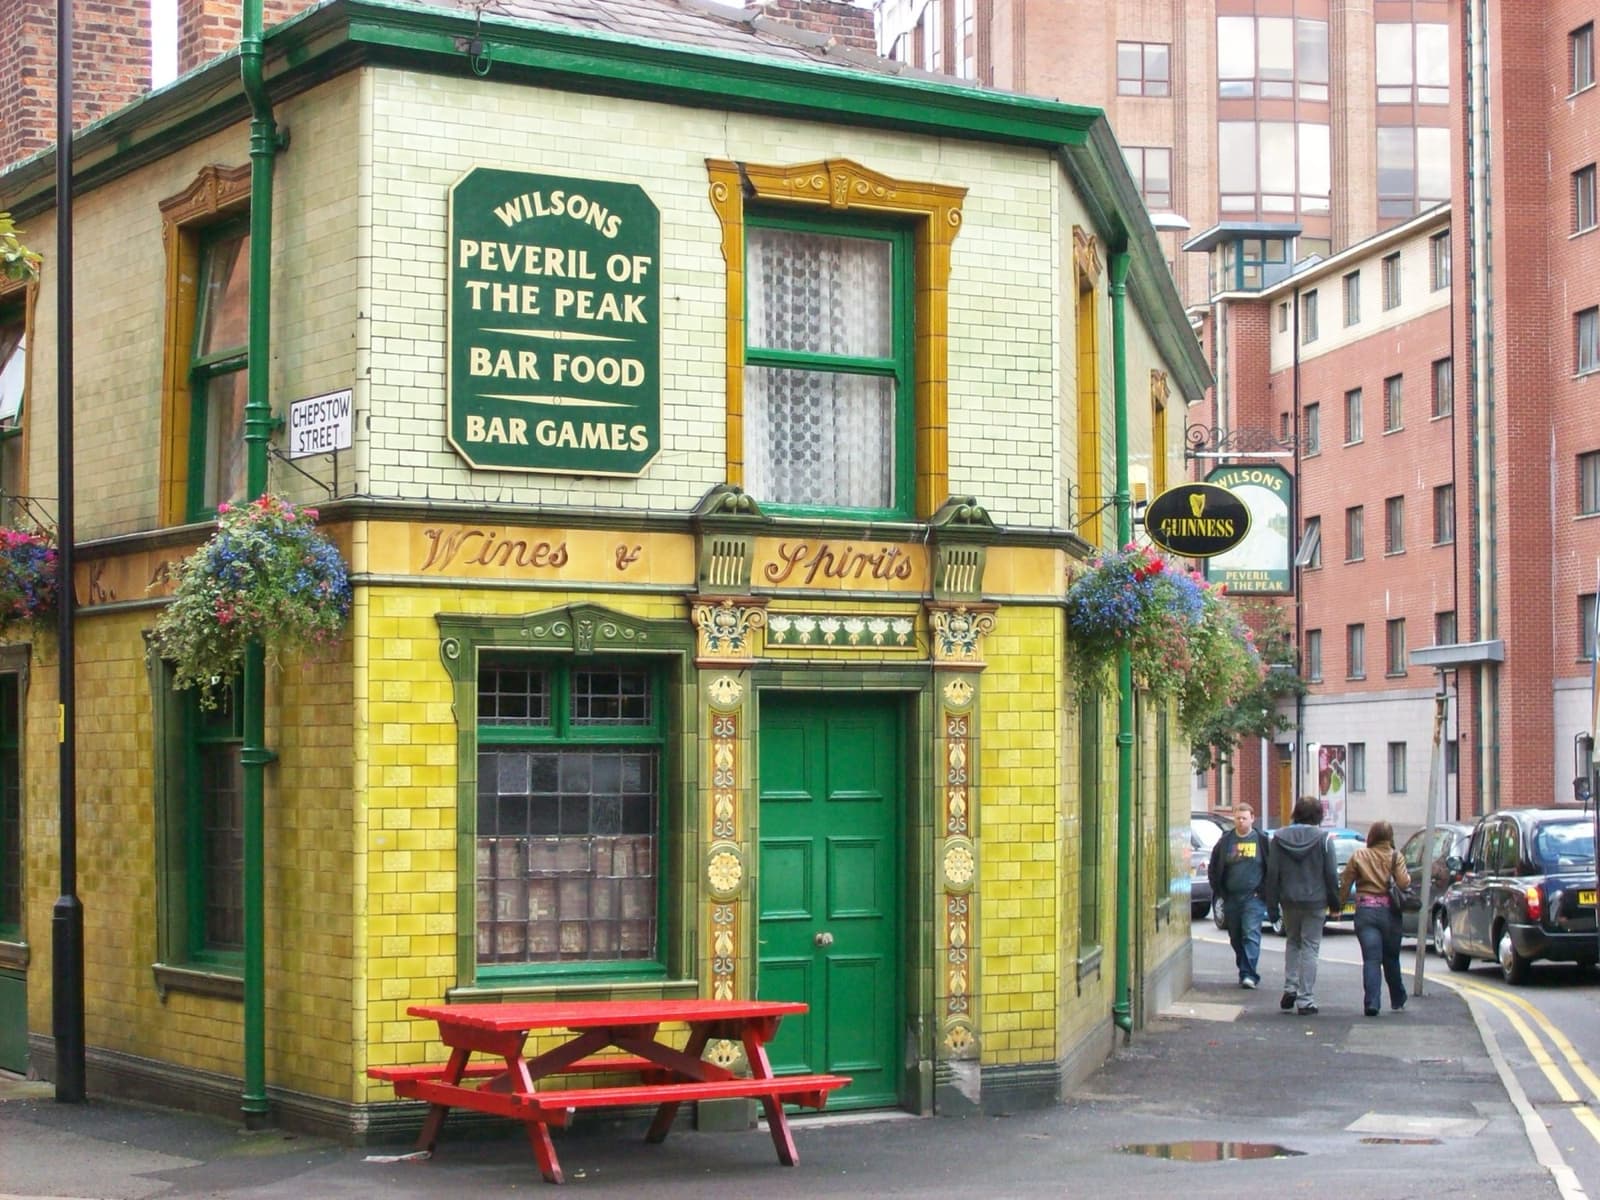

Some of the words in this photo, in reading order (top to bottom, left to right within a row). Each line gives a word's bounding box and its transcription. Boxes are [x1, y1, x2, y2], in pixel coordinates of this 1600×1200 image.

[494, 189, 622, 239] WILSONS
[459, 239, 597, 280] PEVERIL
[606, 254, 651, 284] OF
[465, 281, 540, 314] THE
[555, 288, 648, 324] PEAK
[469, 347, 540, 380] BAR
[553, 353, 645, 387] FOOD
[292, 395, 350, 428] CHEPSTOW
[299, 424, 340, 452] STREET
[466, 415, 529, 445] BAR
[535, 420, 649, 452] GAMES
[1212, 470, 1283, 491] WILSONS
[1161, 518, 1234, 537] GUINNESS
[421, 526, 569, 572] Wines
[615, 543, 642, 572] &
[764, 539, 912, 584] Spirits
[1226, 571, 1270, 580] PEVERIL
[1232, 581, 1253, 591] THE
[1255, 581, 1283, 591] PEAK
